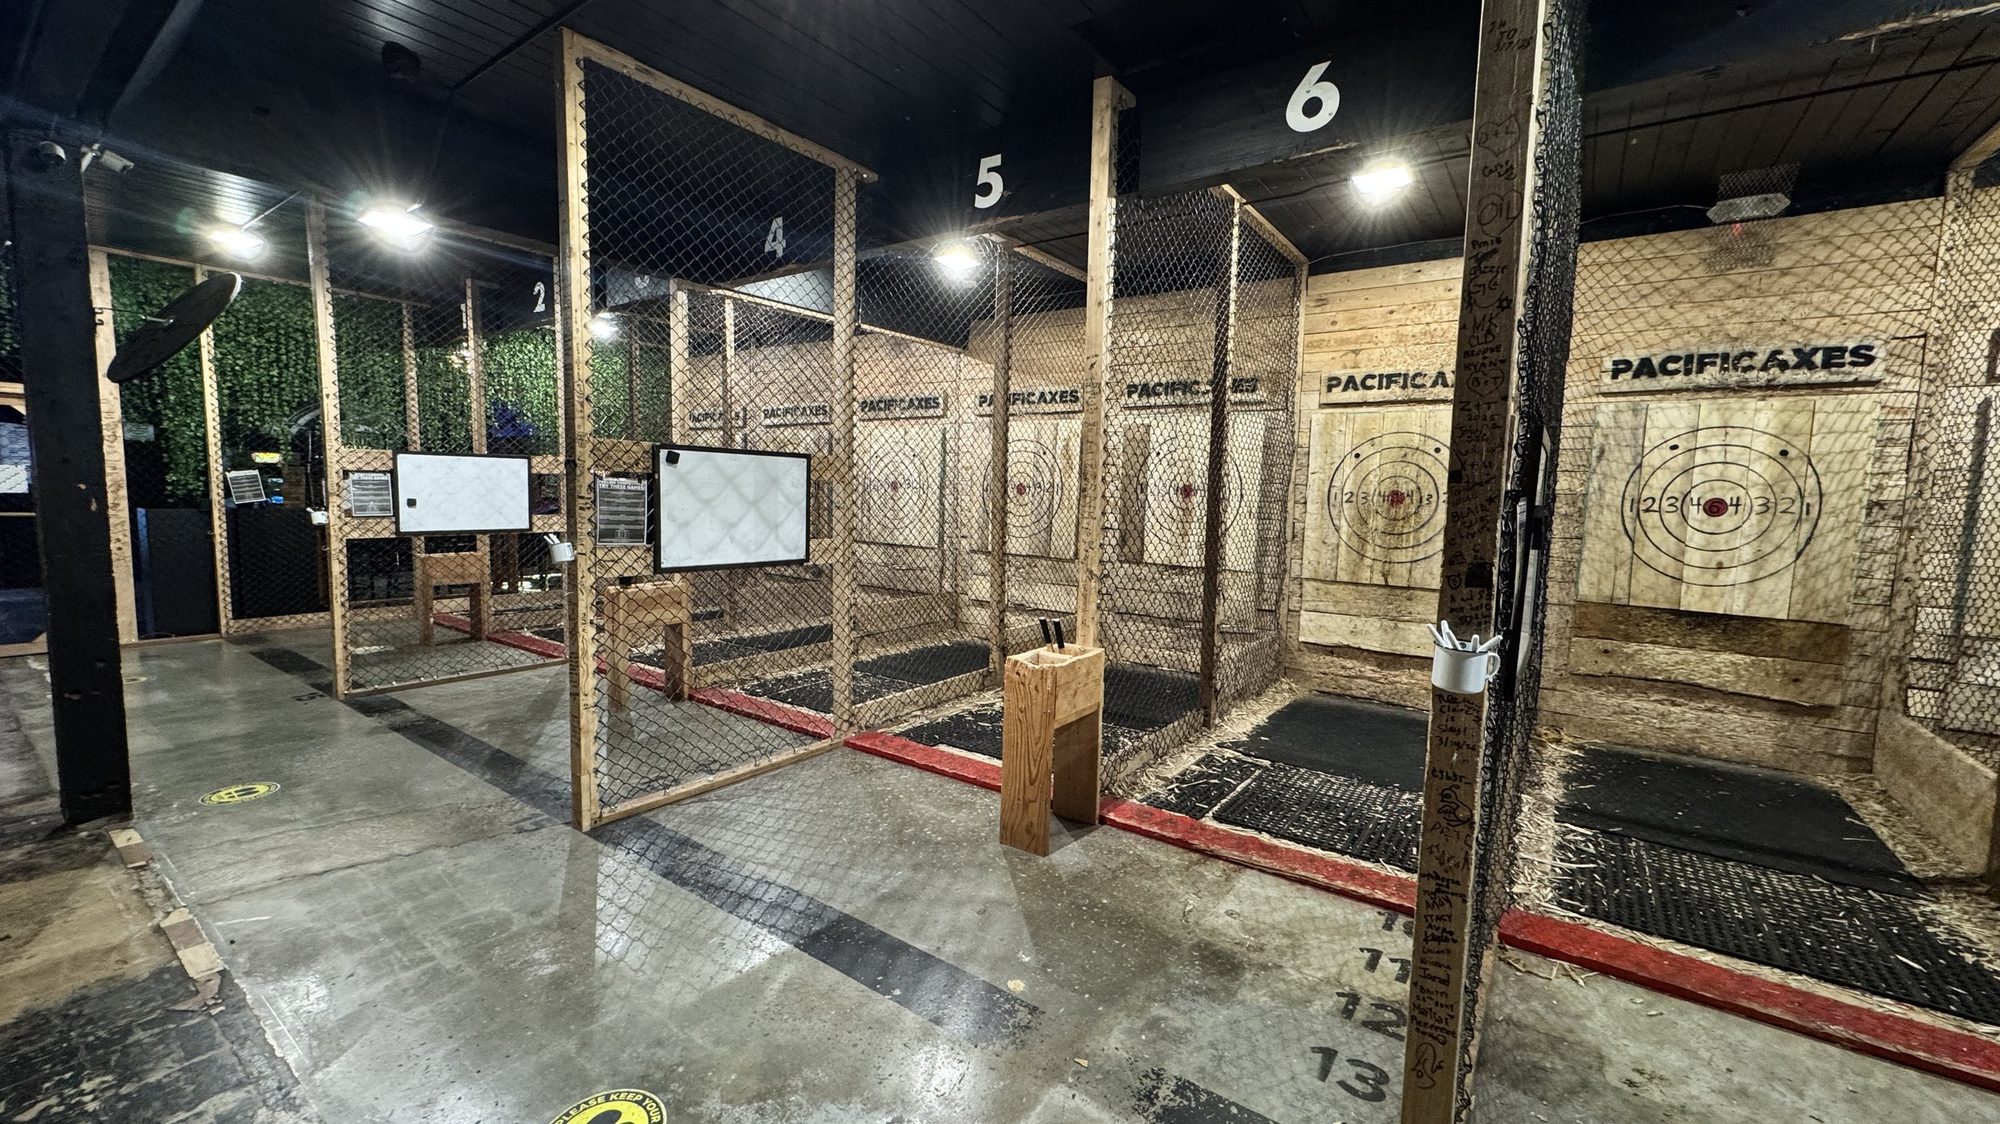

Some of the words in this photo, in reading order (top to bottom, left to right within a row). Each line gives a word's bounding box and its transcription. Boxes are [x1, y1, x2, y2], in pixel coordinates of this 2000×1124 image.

[1285, 60, 1341, 133] 6
[973, 154, 1004, 209] 5
[764, 216, 787, 259] 4
[533, 281, 546, 313] 2
[1611, 345, 1876, 380] PACIFICAXES
[1126, 378, 1259, 398] PACIFICES
[1326, 370, 1455, 393] PACIFICA
[978, 389, 1080, 408] PIFICAXES
[1344, 491, 1355, 503] 2
[1361, 491, 1369, 505] 3
[1425, 494, 1433, 505] 3
[1629, 497, 1634, 513] 1
[1641, 497, 1660, 513] 2
[1665, 496, 1680, 513] 3
[1690, 496, 1702, 515] 4
[1729, 496, 1742, 515] 4
[1754, 497, 1770, 515] 3
[1779, 497, 1796, 515] 2
[1805, 502, 1811, 516] 1
[1358, 947, 1411, 984] 11
[1335, 991, 1407, 1043] 12
[1309, 1046, 1391, 1103] 13
[554, 1095, 606, 1124] PLEASE
[609, 1092, 643, 1102] KEEP
[641, 1097, 661, 1123] YOUR
